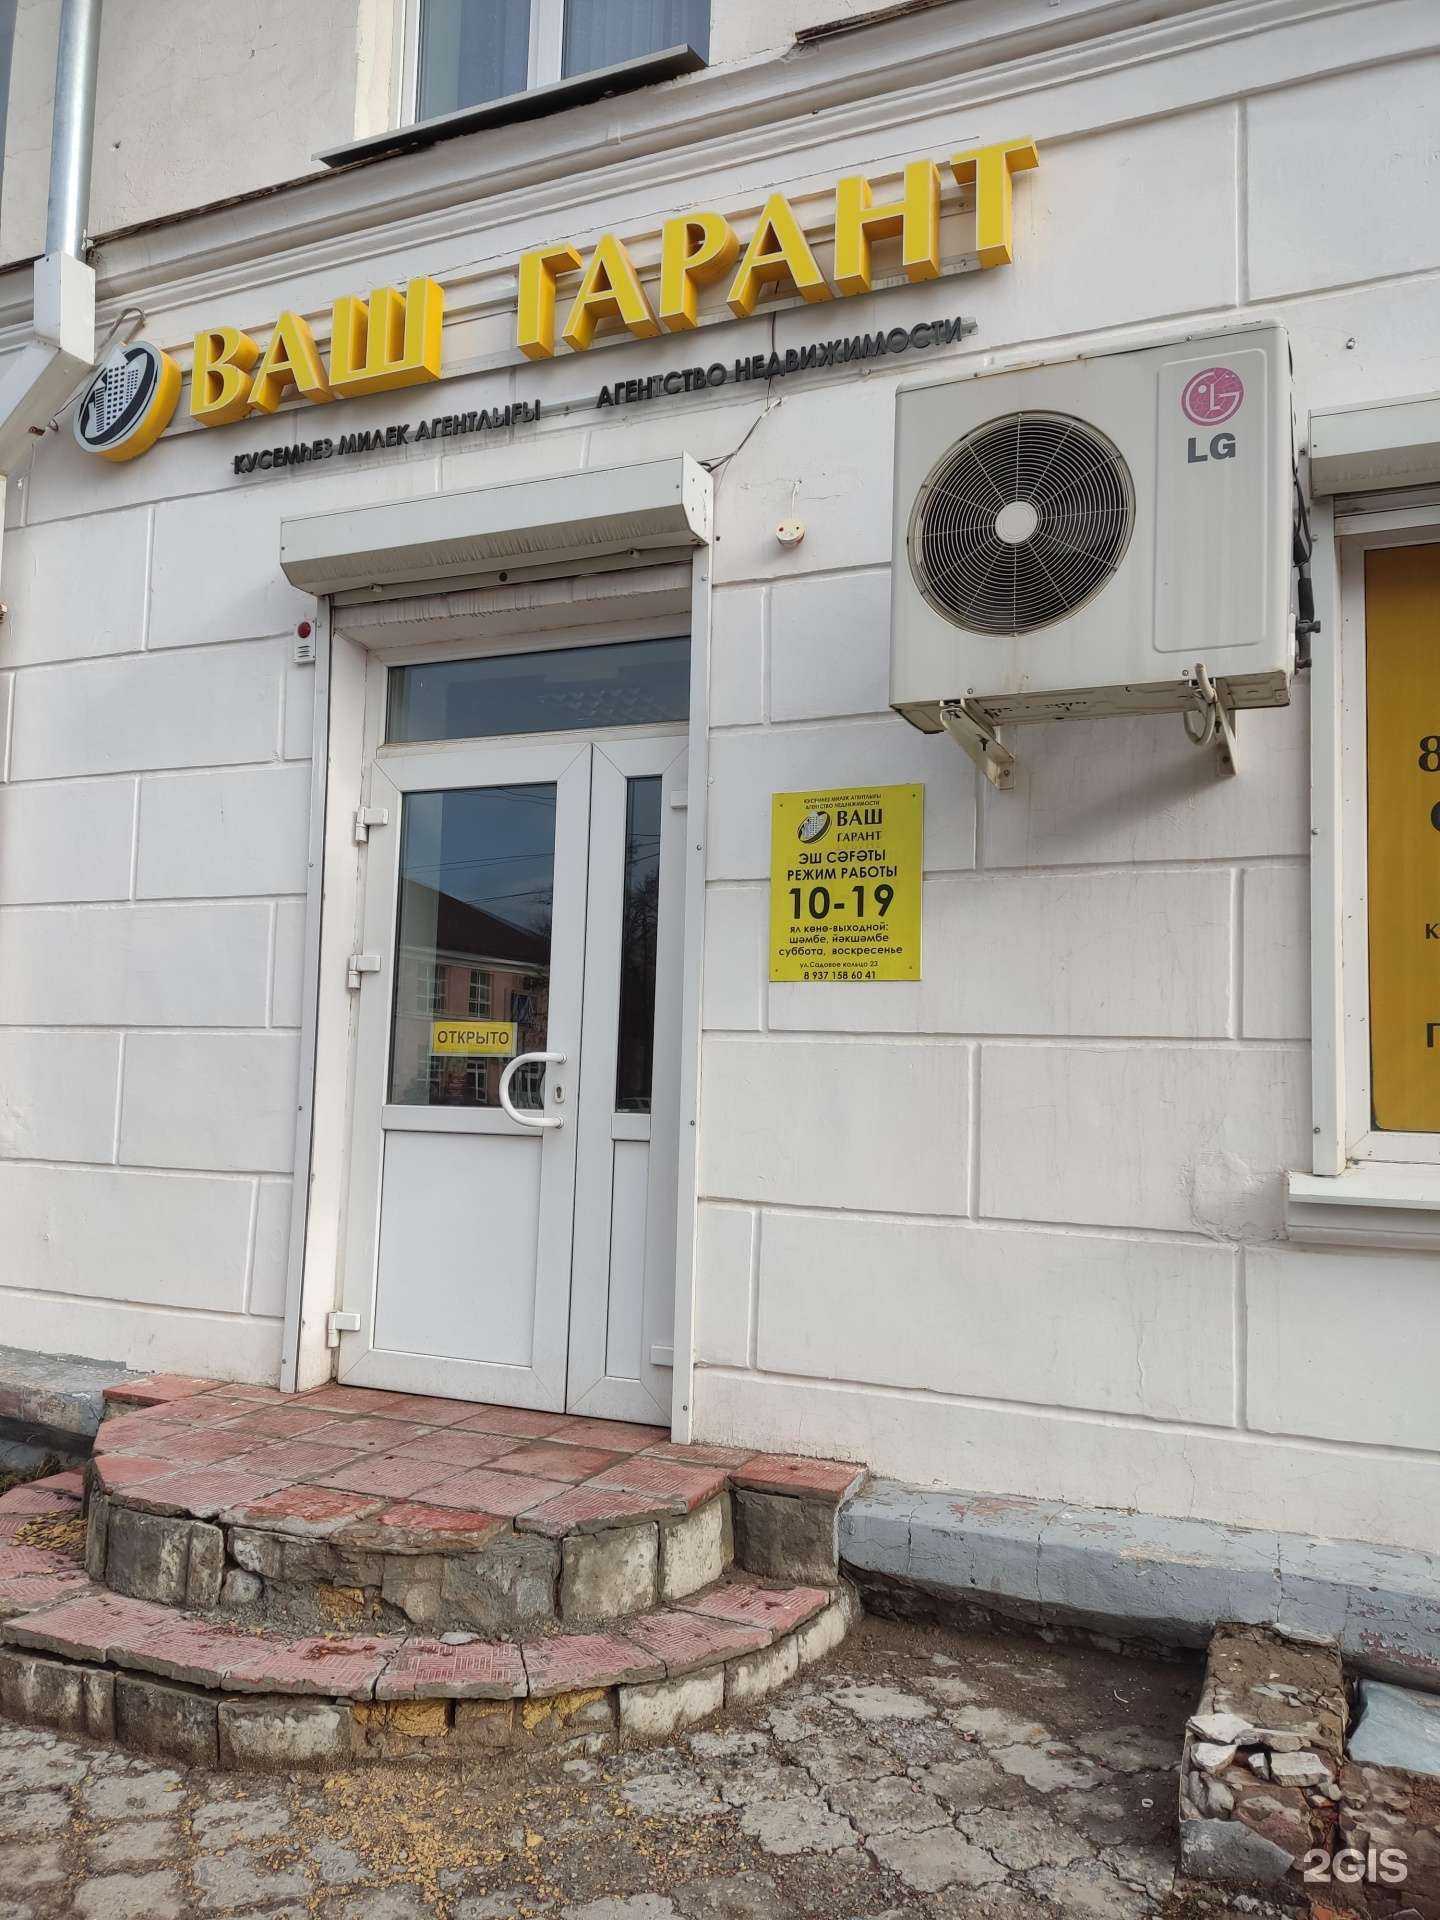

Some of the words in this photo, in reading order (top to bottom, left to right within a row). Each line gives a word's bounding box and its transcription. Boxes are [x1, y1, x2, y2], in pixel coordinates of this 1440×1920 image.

[189, 277, 445, 427] ВАШ
[517, 137, 1039, 359] ГАРАНТ
[597, 363, 727, 408] АГЕНТСТВО
[735, 316, 963, 382] НЕДВИЖИМОСТИ
[338, 424, 410, 455] МИЛЕК
[1187, 432, 1237, 463] LG
[837, 808, 883, 826] ВАШ
[837, 830, 882, 842] ГАРАНТ
[798, 852, 822, 864] ЭШ
[787, 868, 836, 881] РЕЖИМ
[841, 866, 897, 879] РАБОТЫ
[788, 884, 894, 919] 10-19
[790, 925, 801, 933] ял
[778, 946, 826, 958] суббота,
[832, 946, 903, 957] воскресенье
[843, 961, 868, 969] кольцо
[803, 972, 810, 980] 8
[812, 971, 828, 980] 937
[832, 971, 848, 980] 158
[851, 971, 862, 979] 60
[865, 970, 876, 979] 41
[437, 1030, 510, 1045] ОТКРЫТО
